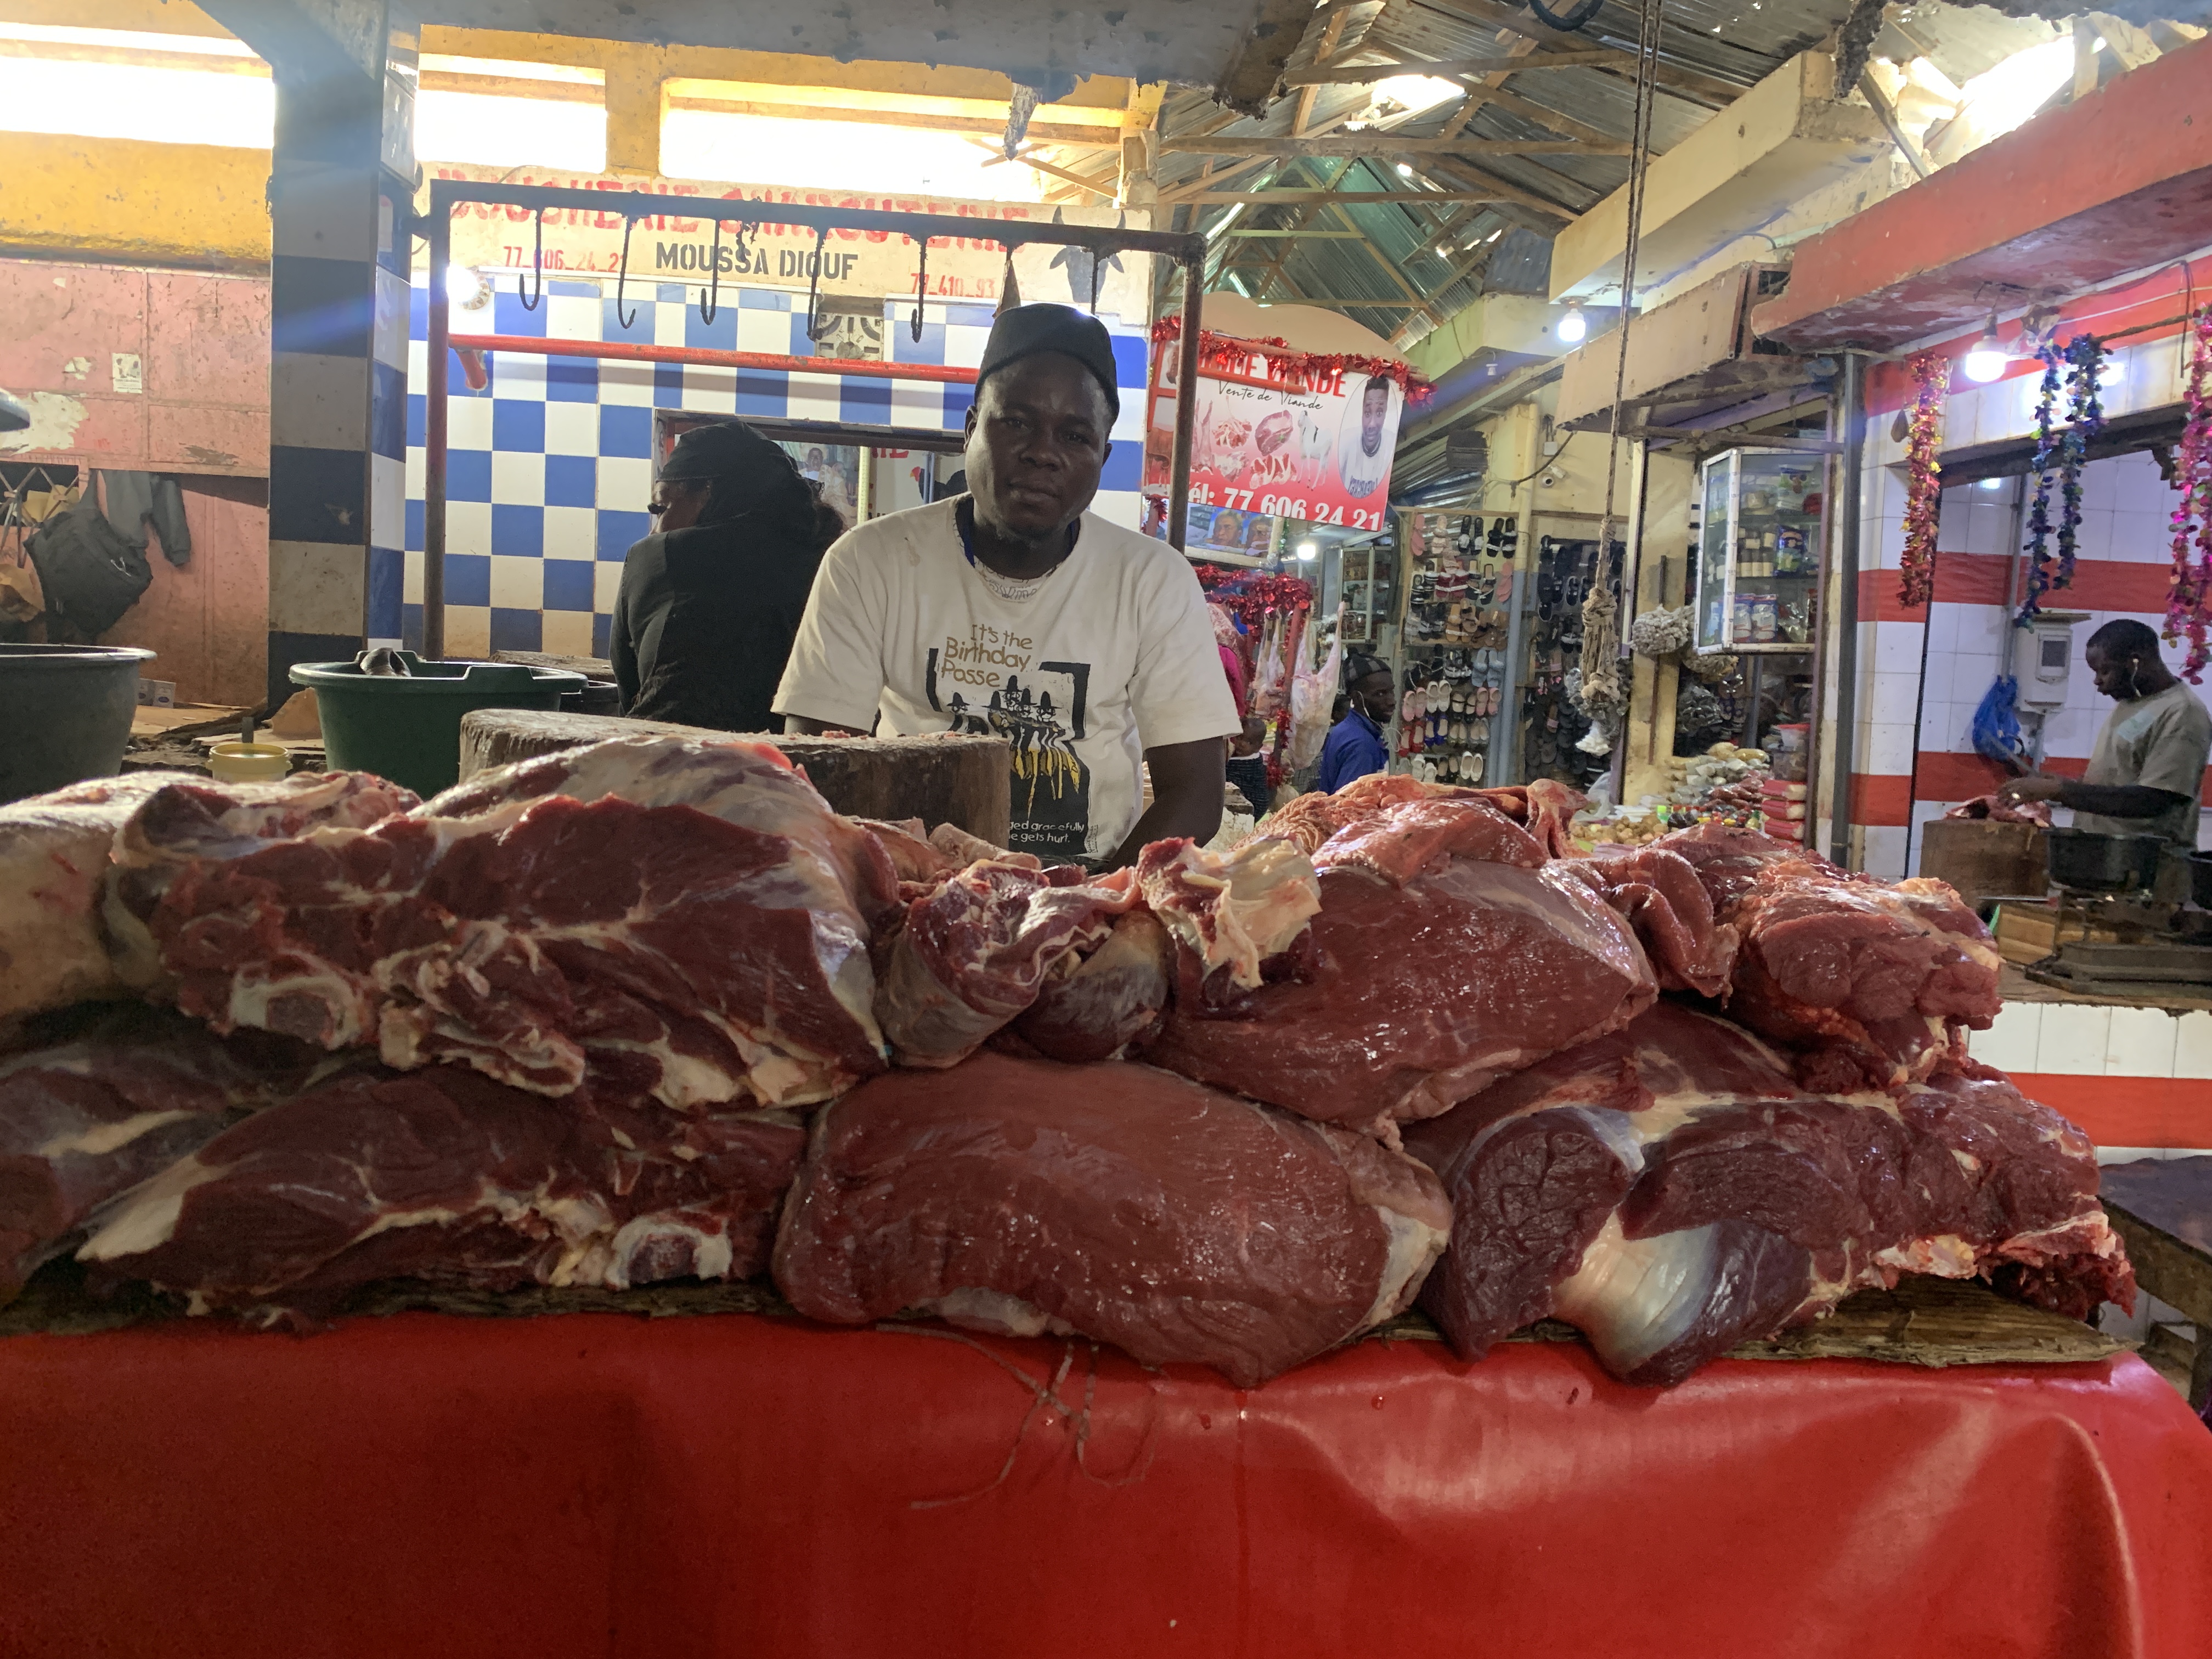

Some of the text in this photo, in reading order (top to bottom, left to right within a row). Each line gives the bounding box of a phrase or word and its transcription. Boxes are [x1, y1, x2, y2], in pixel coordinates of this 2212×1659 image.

[656, 242, 858, 280] MOUSSA DIOUF
[1218, 381, 1323, 410] Vente de Viande
[1189, 481, 1380, 532] él: 77 606 24 21
[970, 624, 1032, 650] It's the
[945, 636, 1031, 672] Birthday
[941, 658, 1000, 687] Posse
[1020, 832, 1045, 843] gets
[1047, 832, 1070, 844] hurt.
[1030, 822, 1085, 833] gracefully
